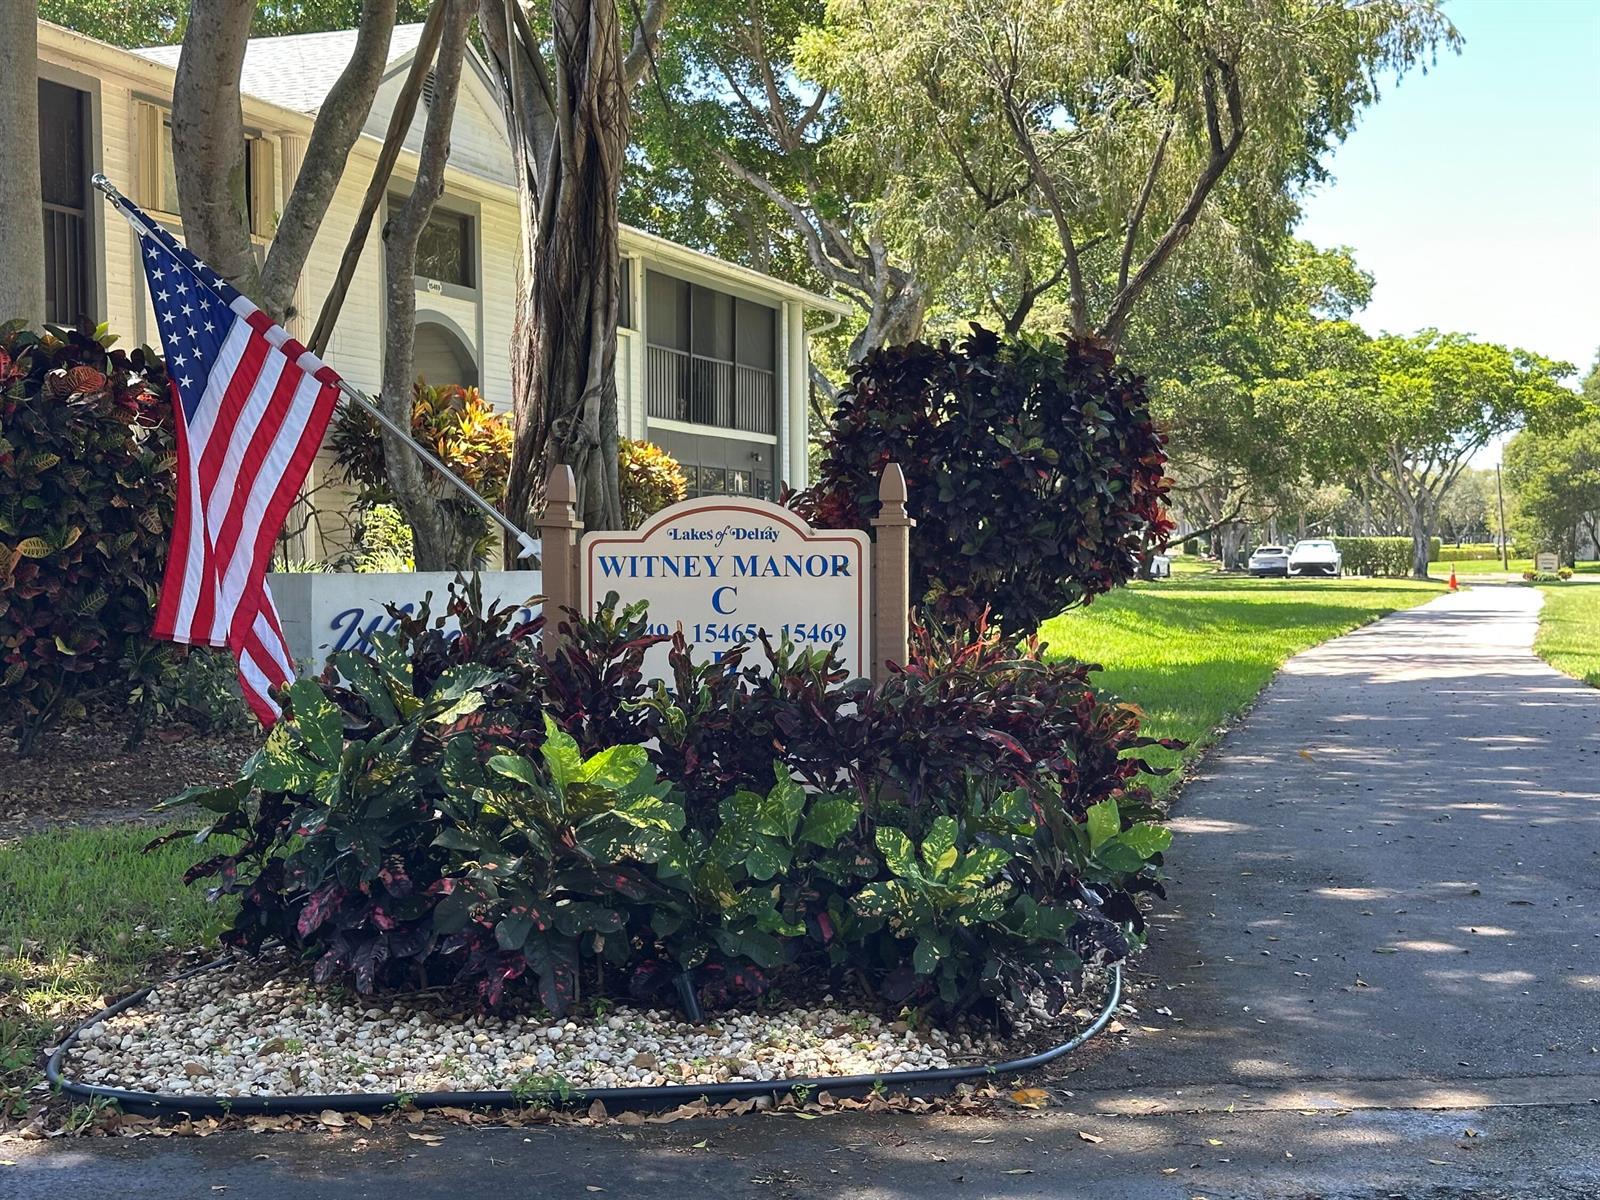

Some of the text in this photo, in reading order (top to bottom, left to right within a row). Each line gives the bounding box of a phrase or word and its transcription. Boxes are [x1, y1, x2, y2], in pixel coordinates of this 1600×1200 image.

[667, 525, 780, 548] Lakes of Delray
[598, 554, 852, 578] WITNEY MANOR
[711, 586, 738, 615] C
